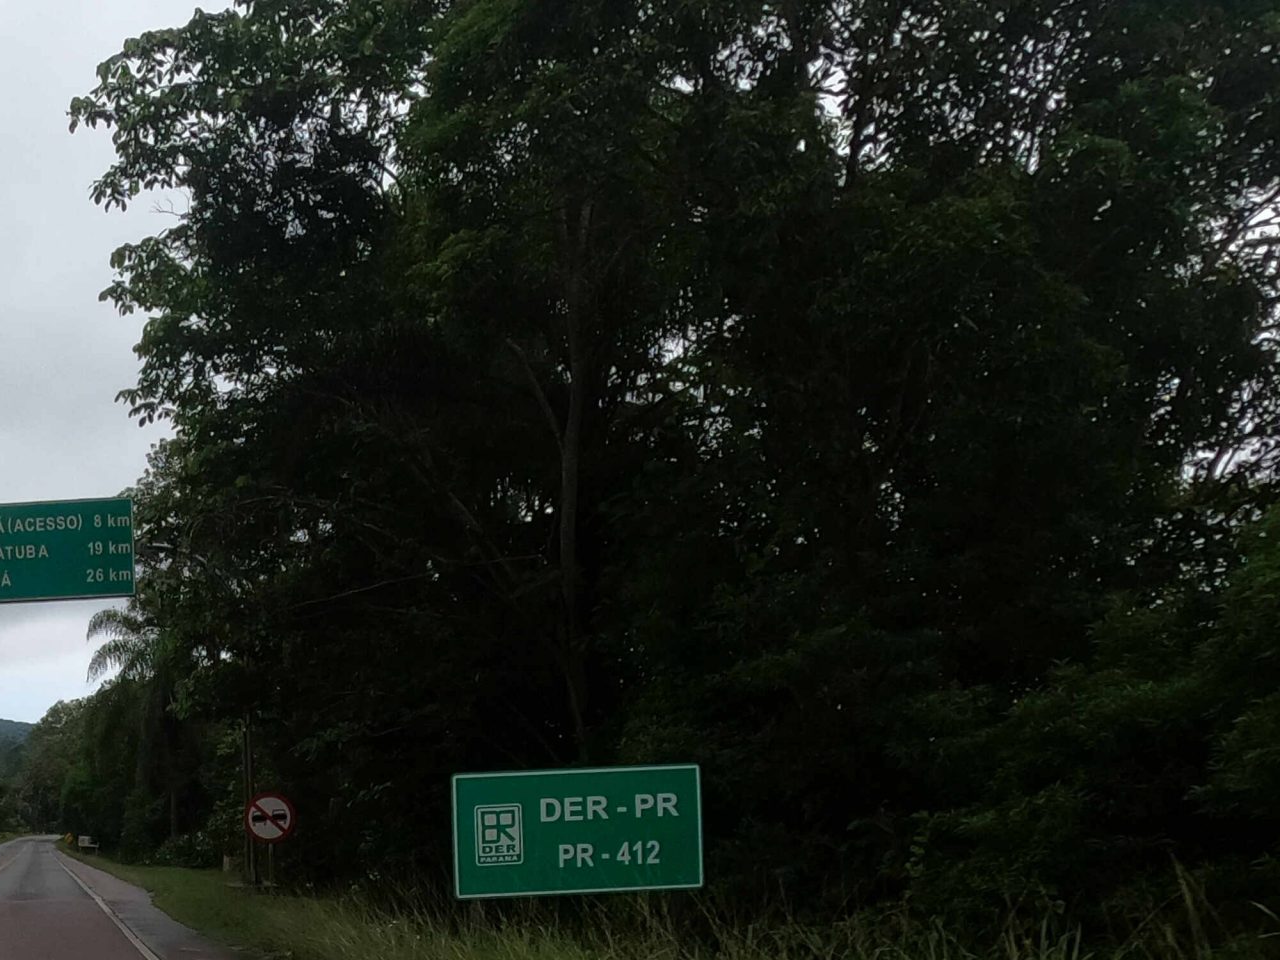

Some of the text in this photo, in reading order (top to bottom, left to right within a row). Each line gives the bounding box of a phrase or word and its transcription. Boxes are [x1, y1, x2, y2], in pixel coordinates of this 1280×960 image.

[93, 514, 102, 528] 8
[107, 513, 130, 528] km
[87, 541, 103, 556] 19
[109, 541, 131, 554] km
[86, 568, 104, 583] 26
[109, 568, 131, 581] km
[539, 795, 609, 822] DER
[634, 793, 679, 818] PR
[482, 844, 516, 855] DER
[616, 840, 660, 865] 412
